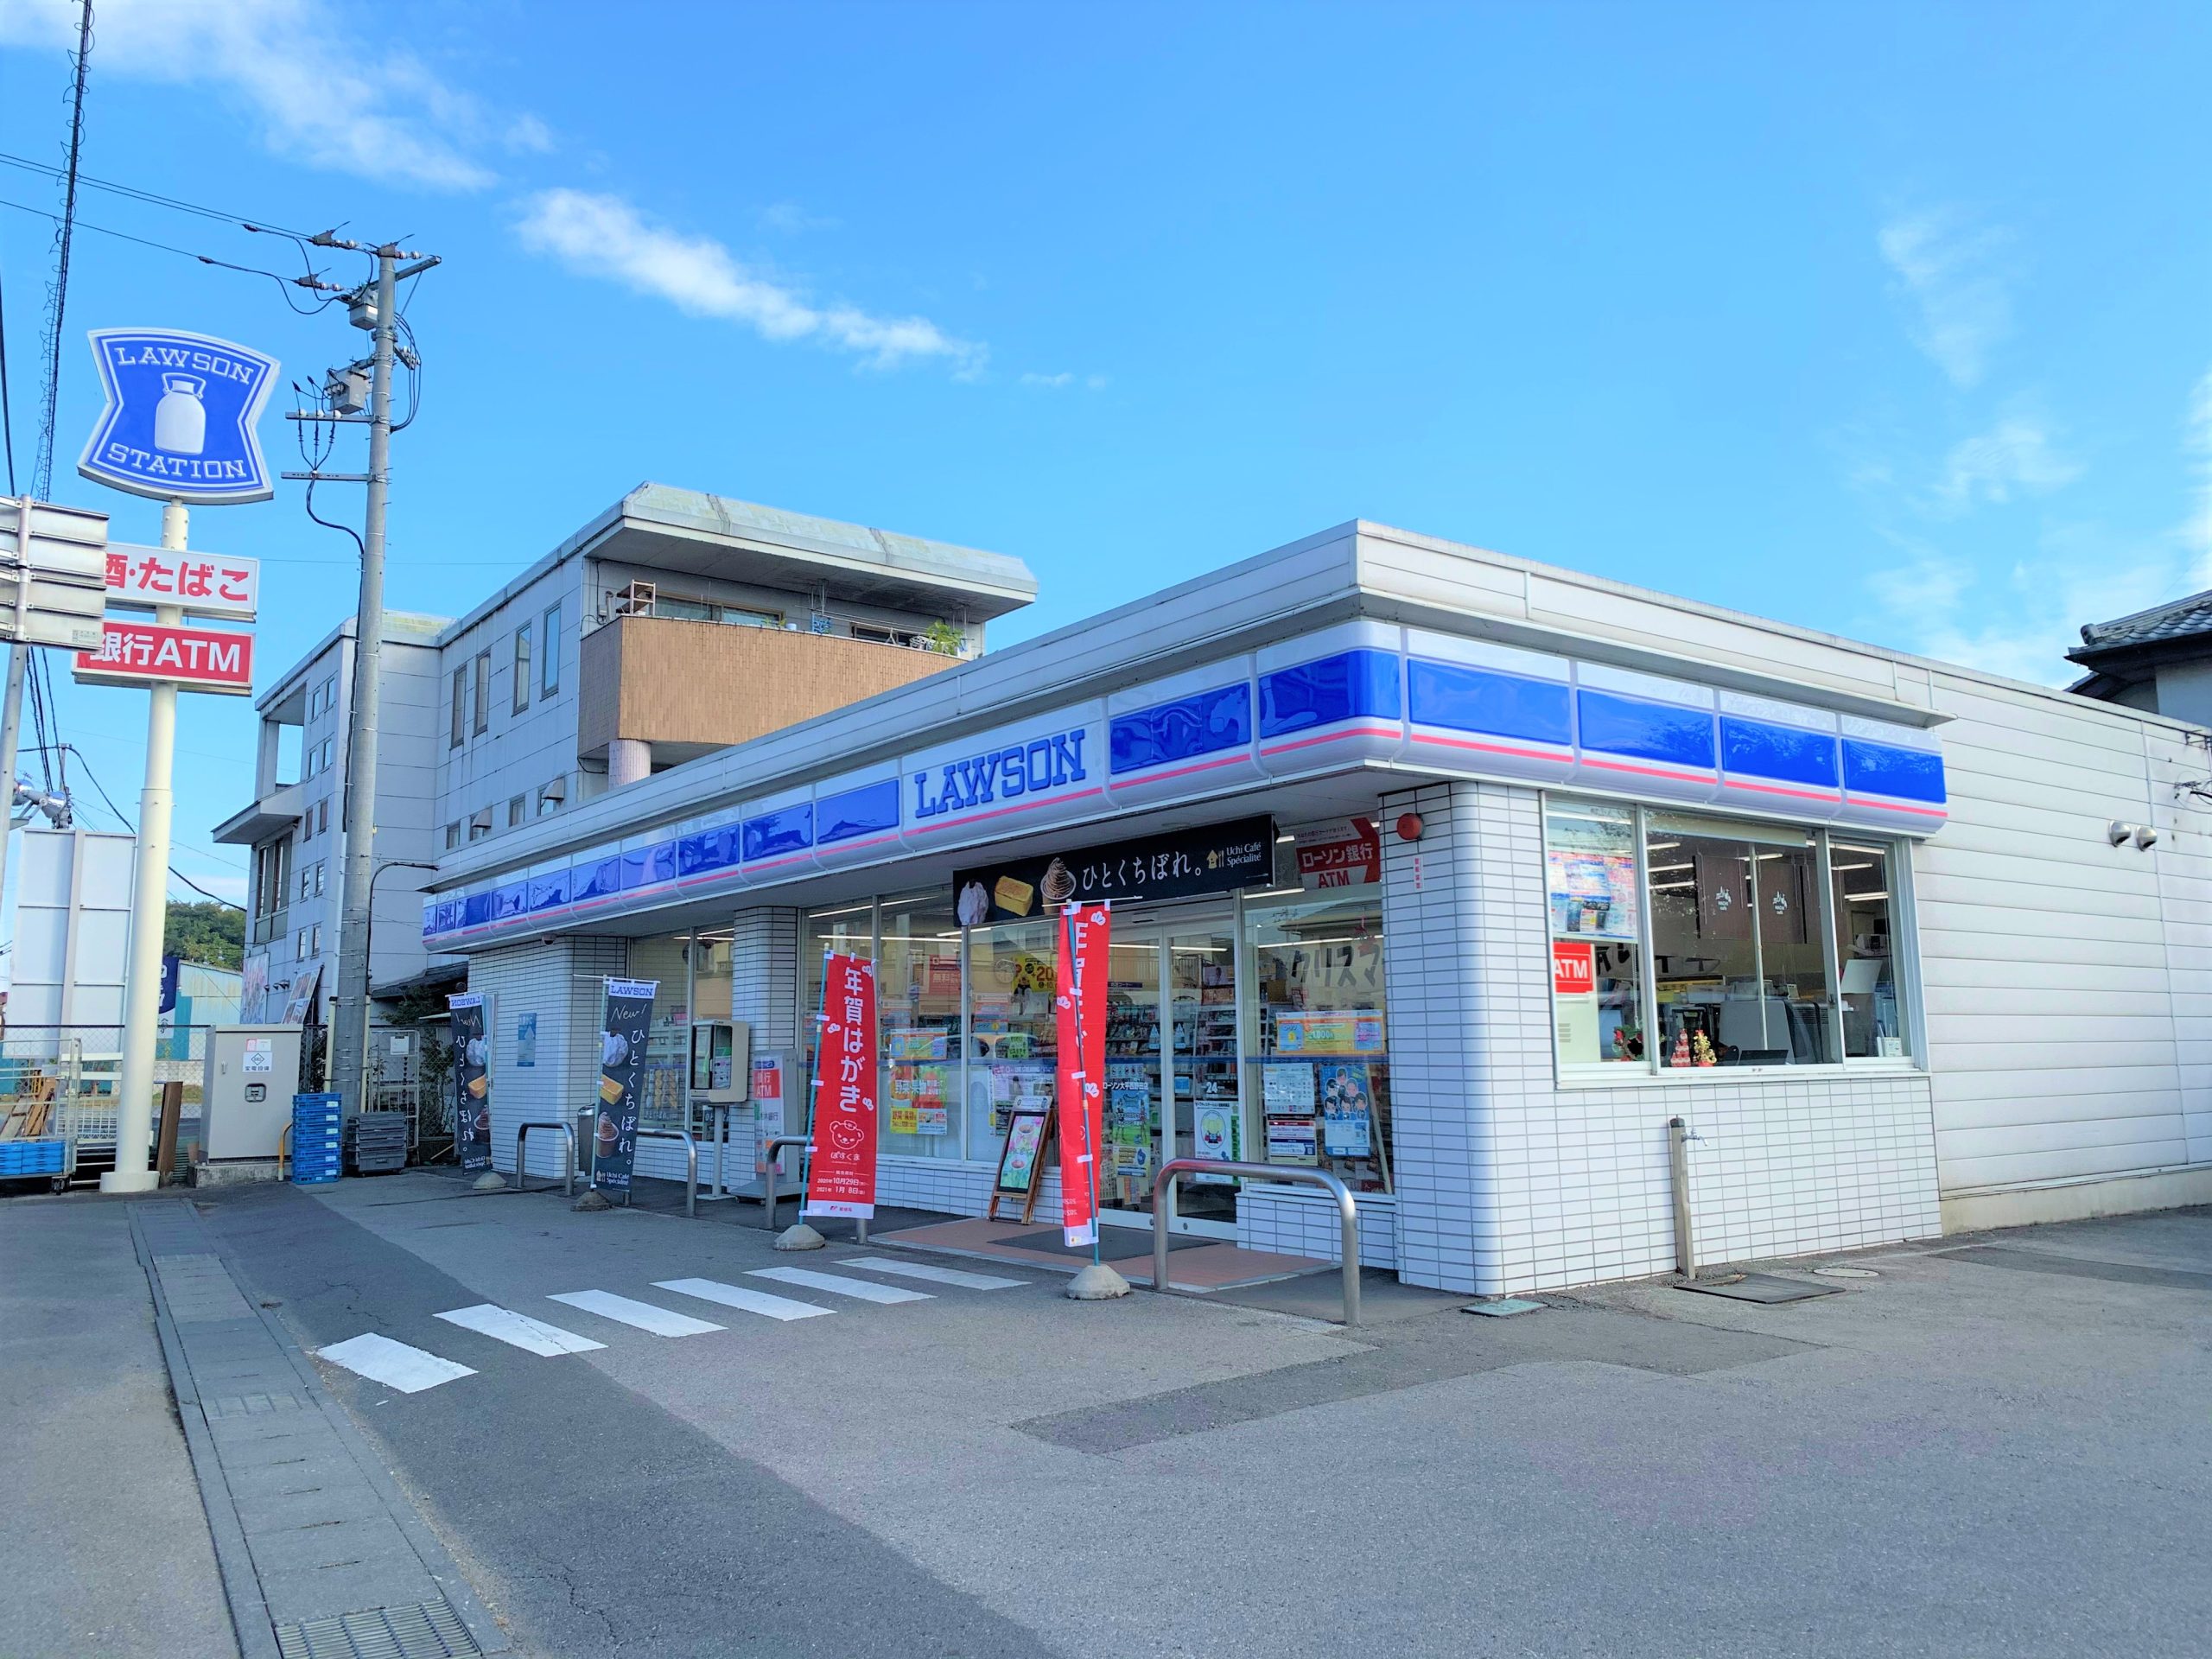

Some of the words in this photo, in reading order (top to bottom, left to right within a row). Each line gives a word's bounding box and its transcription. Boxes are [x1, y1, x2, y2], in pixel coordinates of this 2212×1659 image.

[114, 346, 254, 385] LAWSON
[106, 442, 247, 479] STATION
[90, 632, 241, 673] 銀行ATM
[914, 728, 1085, 818] LAWSON
[1226, 845, 1243, 856] Uchi
[1244, 842, 1262, 853] Café
[1226, 852, 1262, 868] Spécialité
[1301, 842, 1374, 868] ローソン銀行
[1083, 851, 1202, 891] ひとくちぼれ。
[1319, 870, 1350, 888] ATM
[1554, 958, 1588, 979] ATM
[610, 985, 654, 996] LAWSON
[610, 1003, 647, 1022] New!
[840, 967, 866, 1113] 年賀はがき
[618, 1029, 645, 1165] ひとくちぼれ。
[756, 1084, 772, 1096] ATM
